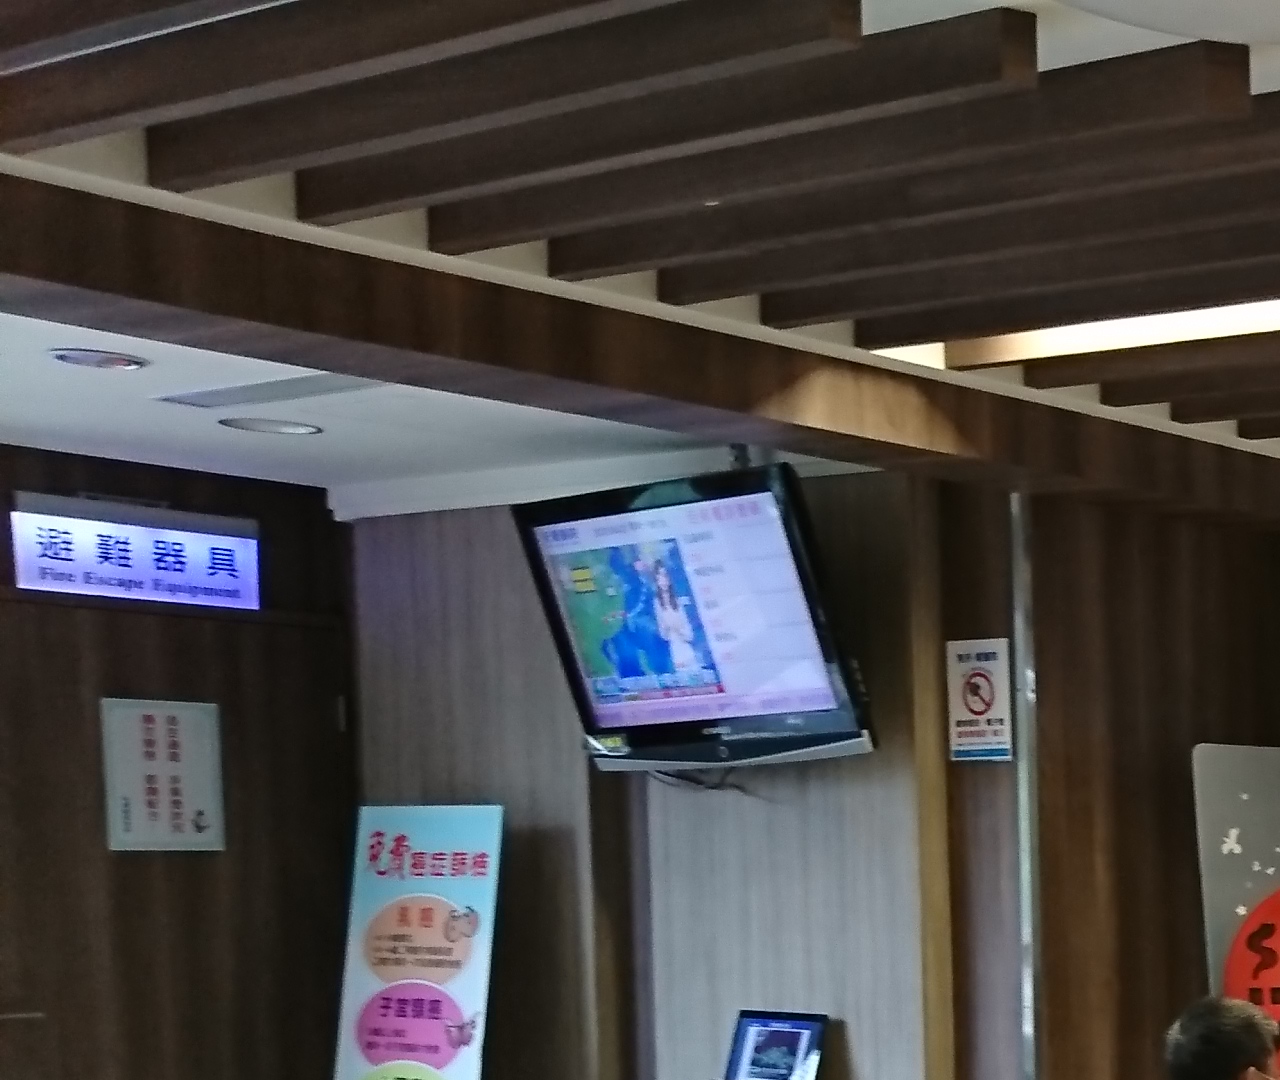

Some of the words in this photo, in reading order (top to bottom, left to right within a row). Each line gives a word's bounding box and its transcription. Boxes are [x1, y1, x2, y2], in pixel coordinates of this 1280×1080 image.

[36, 526, 240, 579] 避難器具
[38, 567, 77, 583] Fire
[83, 571, 145, 591] Escape
[151, 578, 242, 599] Equipment
